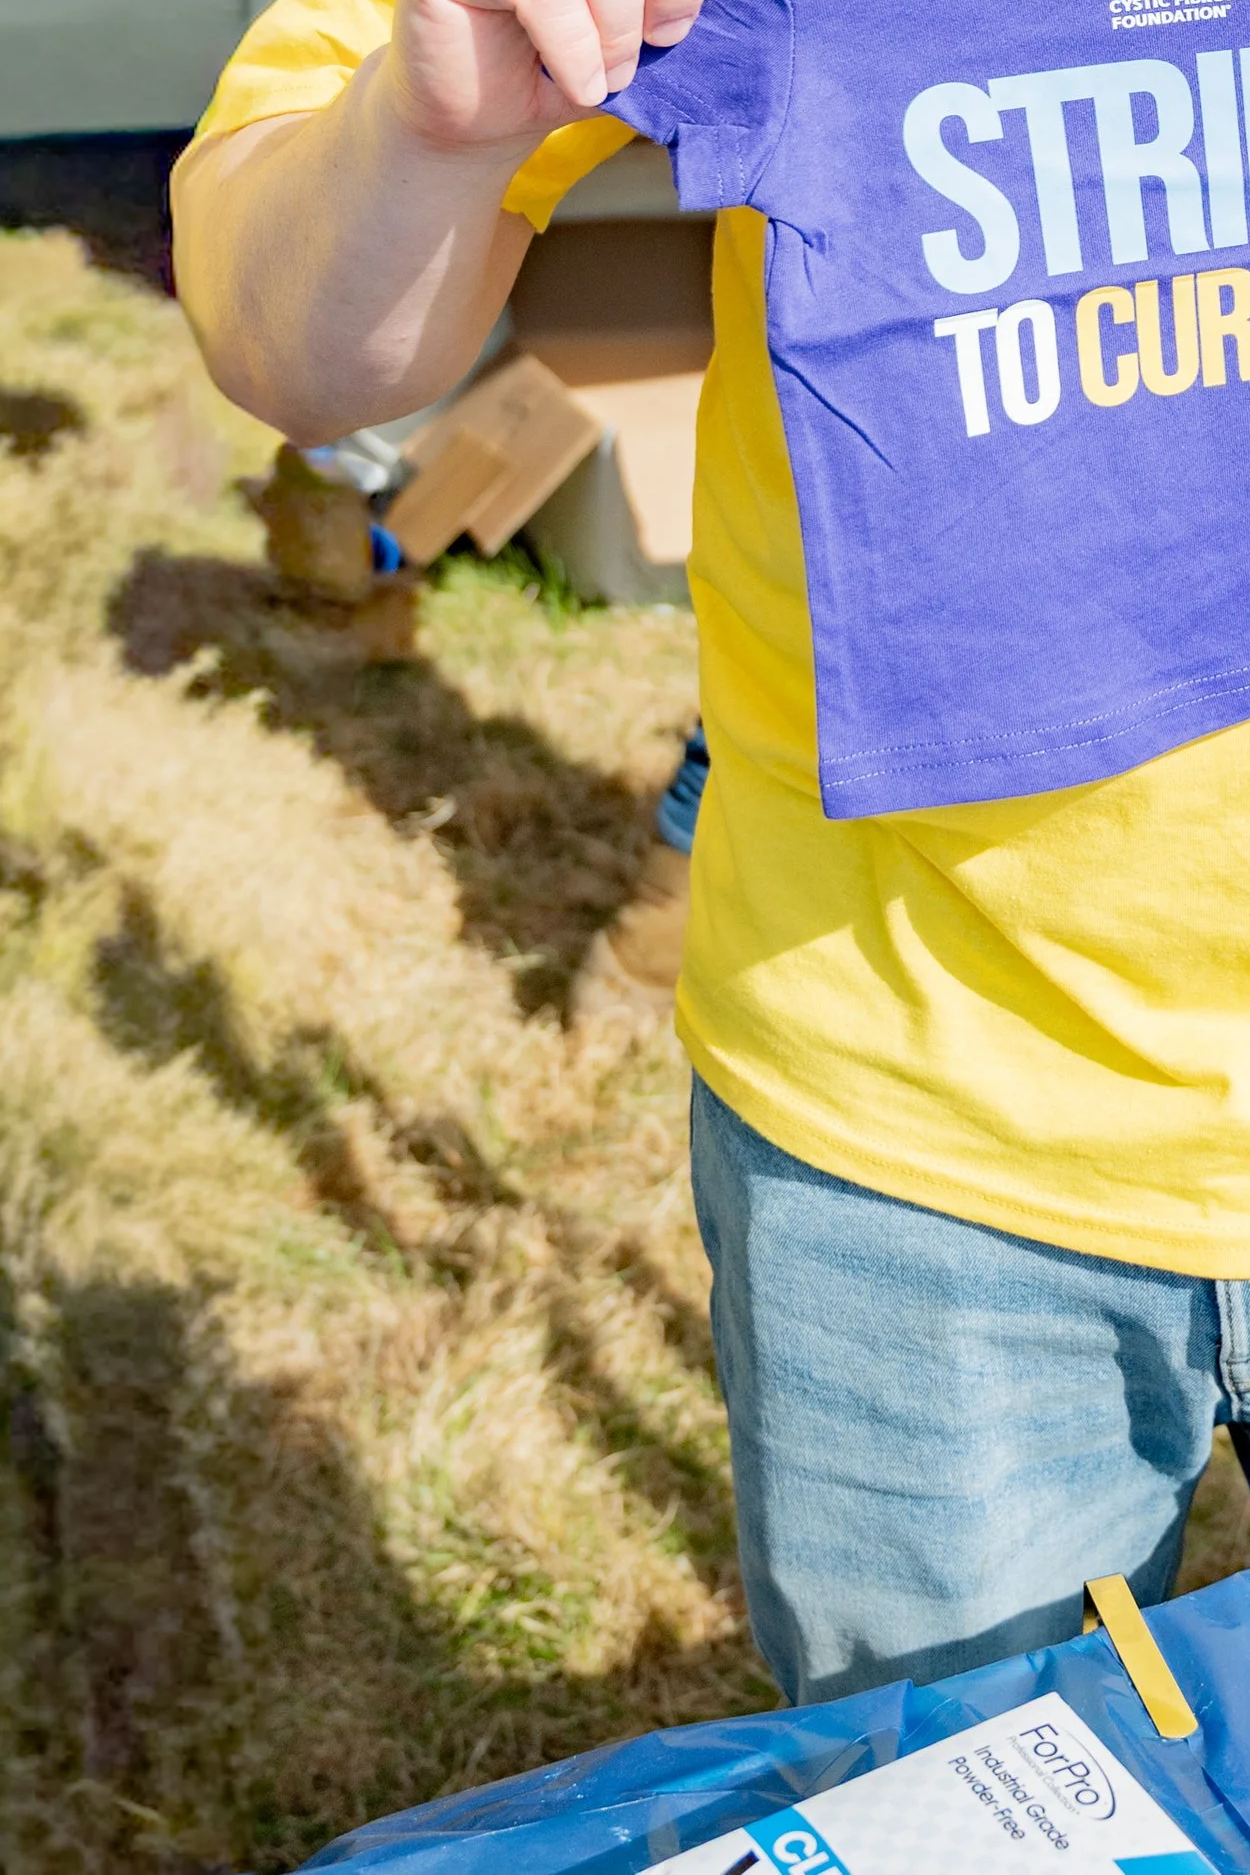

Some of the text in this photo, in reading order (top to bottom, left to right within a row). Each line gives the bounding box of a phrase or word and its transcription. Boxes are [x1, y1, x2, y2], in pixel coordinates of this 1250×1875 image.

[933, 299, 1062, 438] TO
[947, 1756, 1025, 1840] Powder-Free
[974, 1744, 1070, 1851] Industrial Grade
[1019, 1723, 1099, 1805] ForPro
